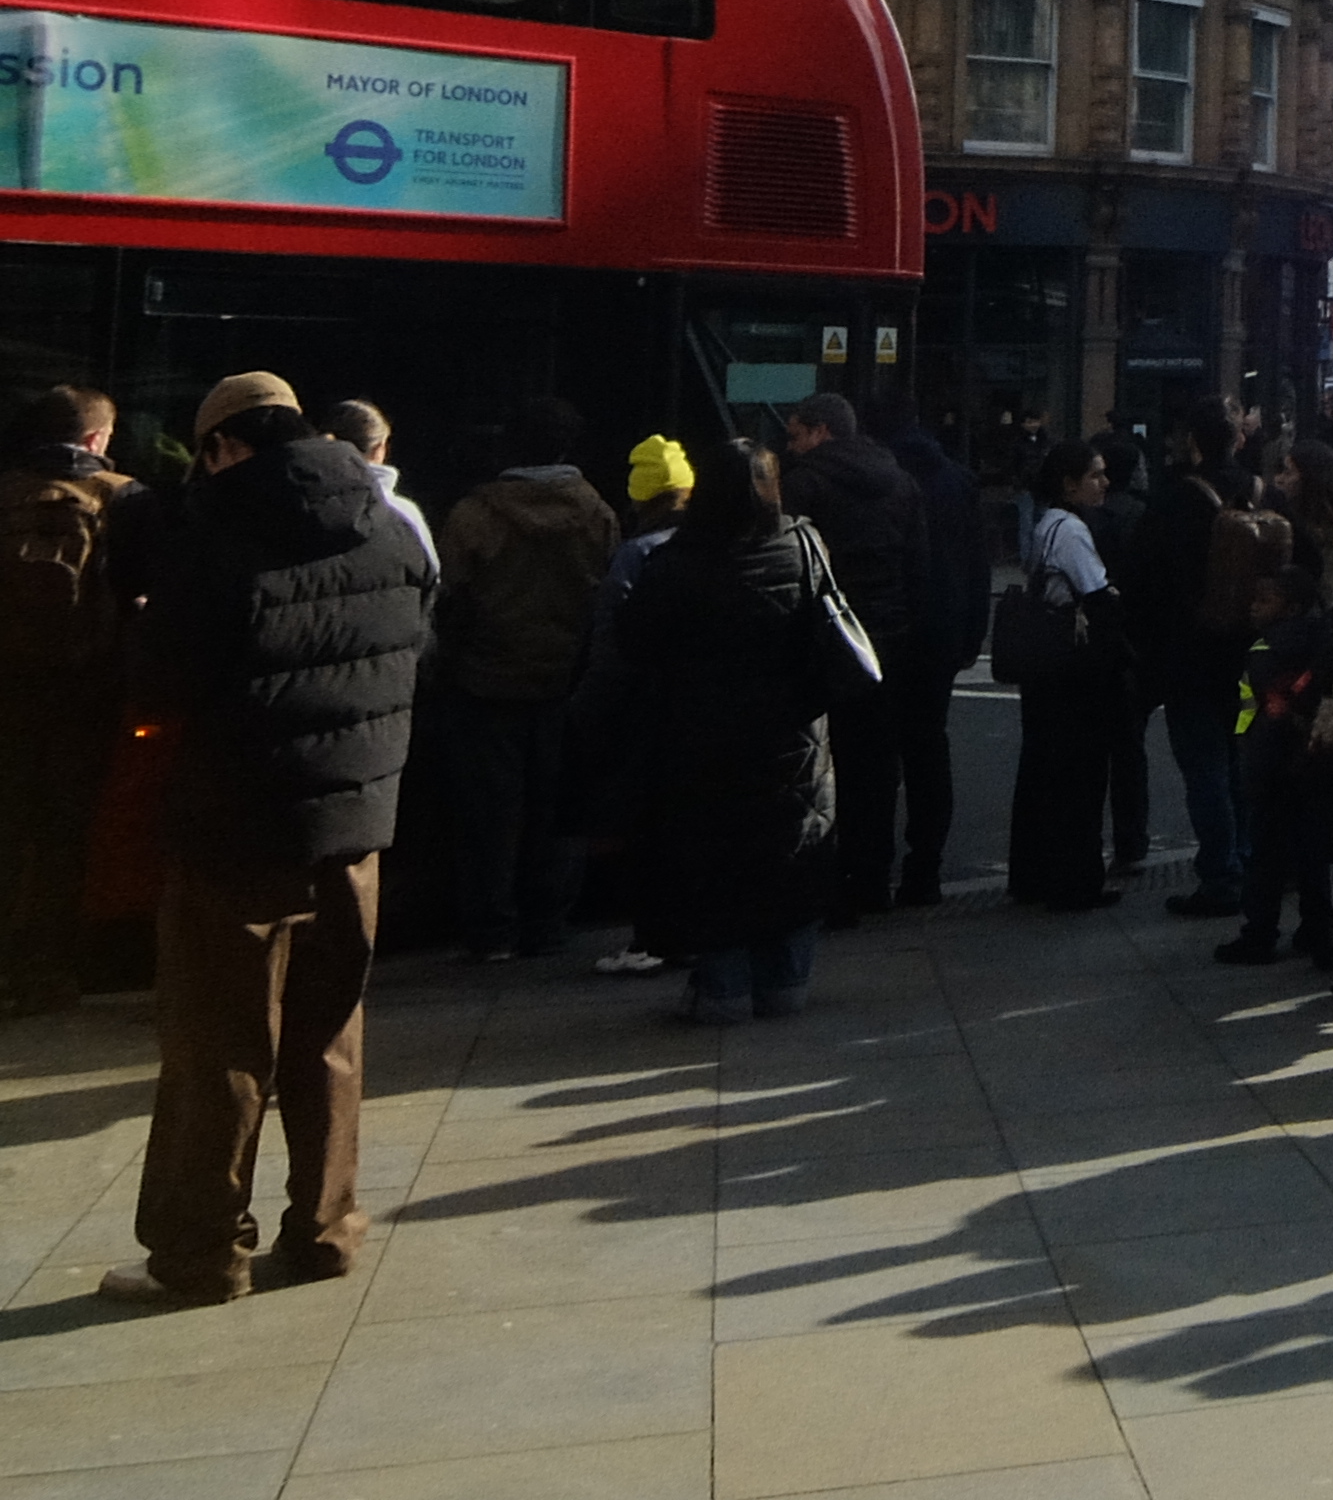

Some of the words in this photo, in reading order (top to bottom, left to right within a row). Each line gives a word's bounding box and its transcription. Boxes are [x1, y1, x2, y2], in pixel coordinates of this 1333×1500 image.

[0, 47, 143, 94] ssion
[326, 74, 399, 95] MAYOR
[407, 81, 435, 98] OF
[441, 84, 528, 106] LONDON
[415, 128, 515, 149] TRANSPORT
[413, 149, 447, 165] FOR
[452, 152, 525, 170] LONDON
[924, 189, 998, 234] ON
